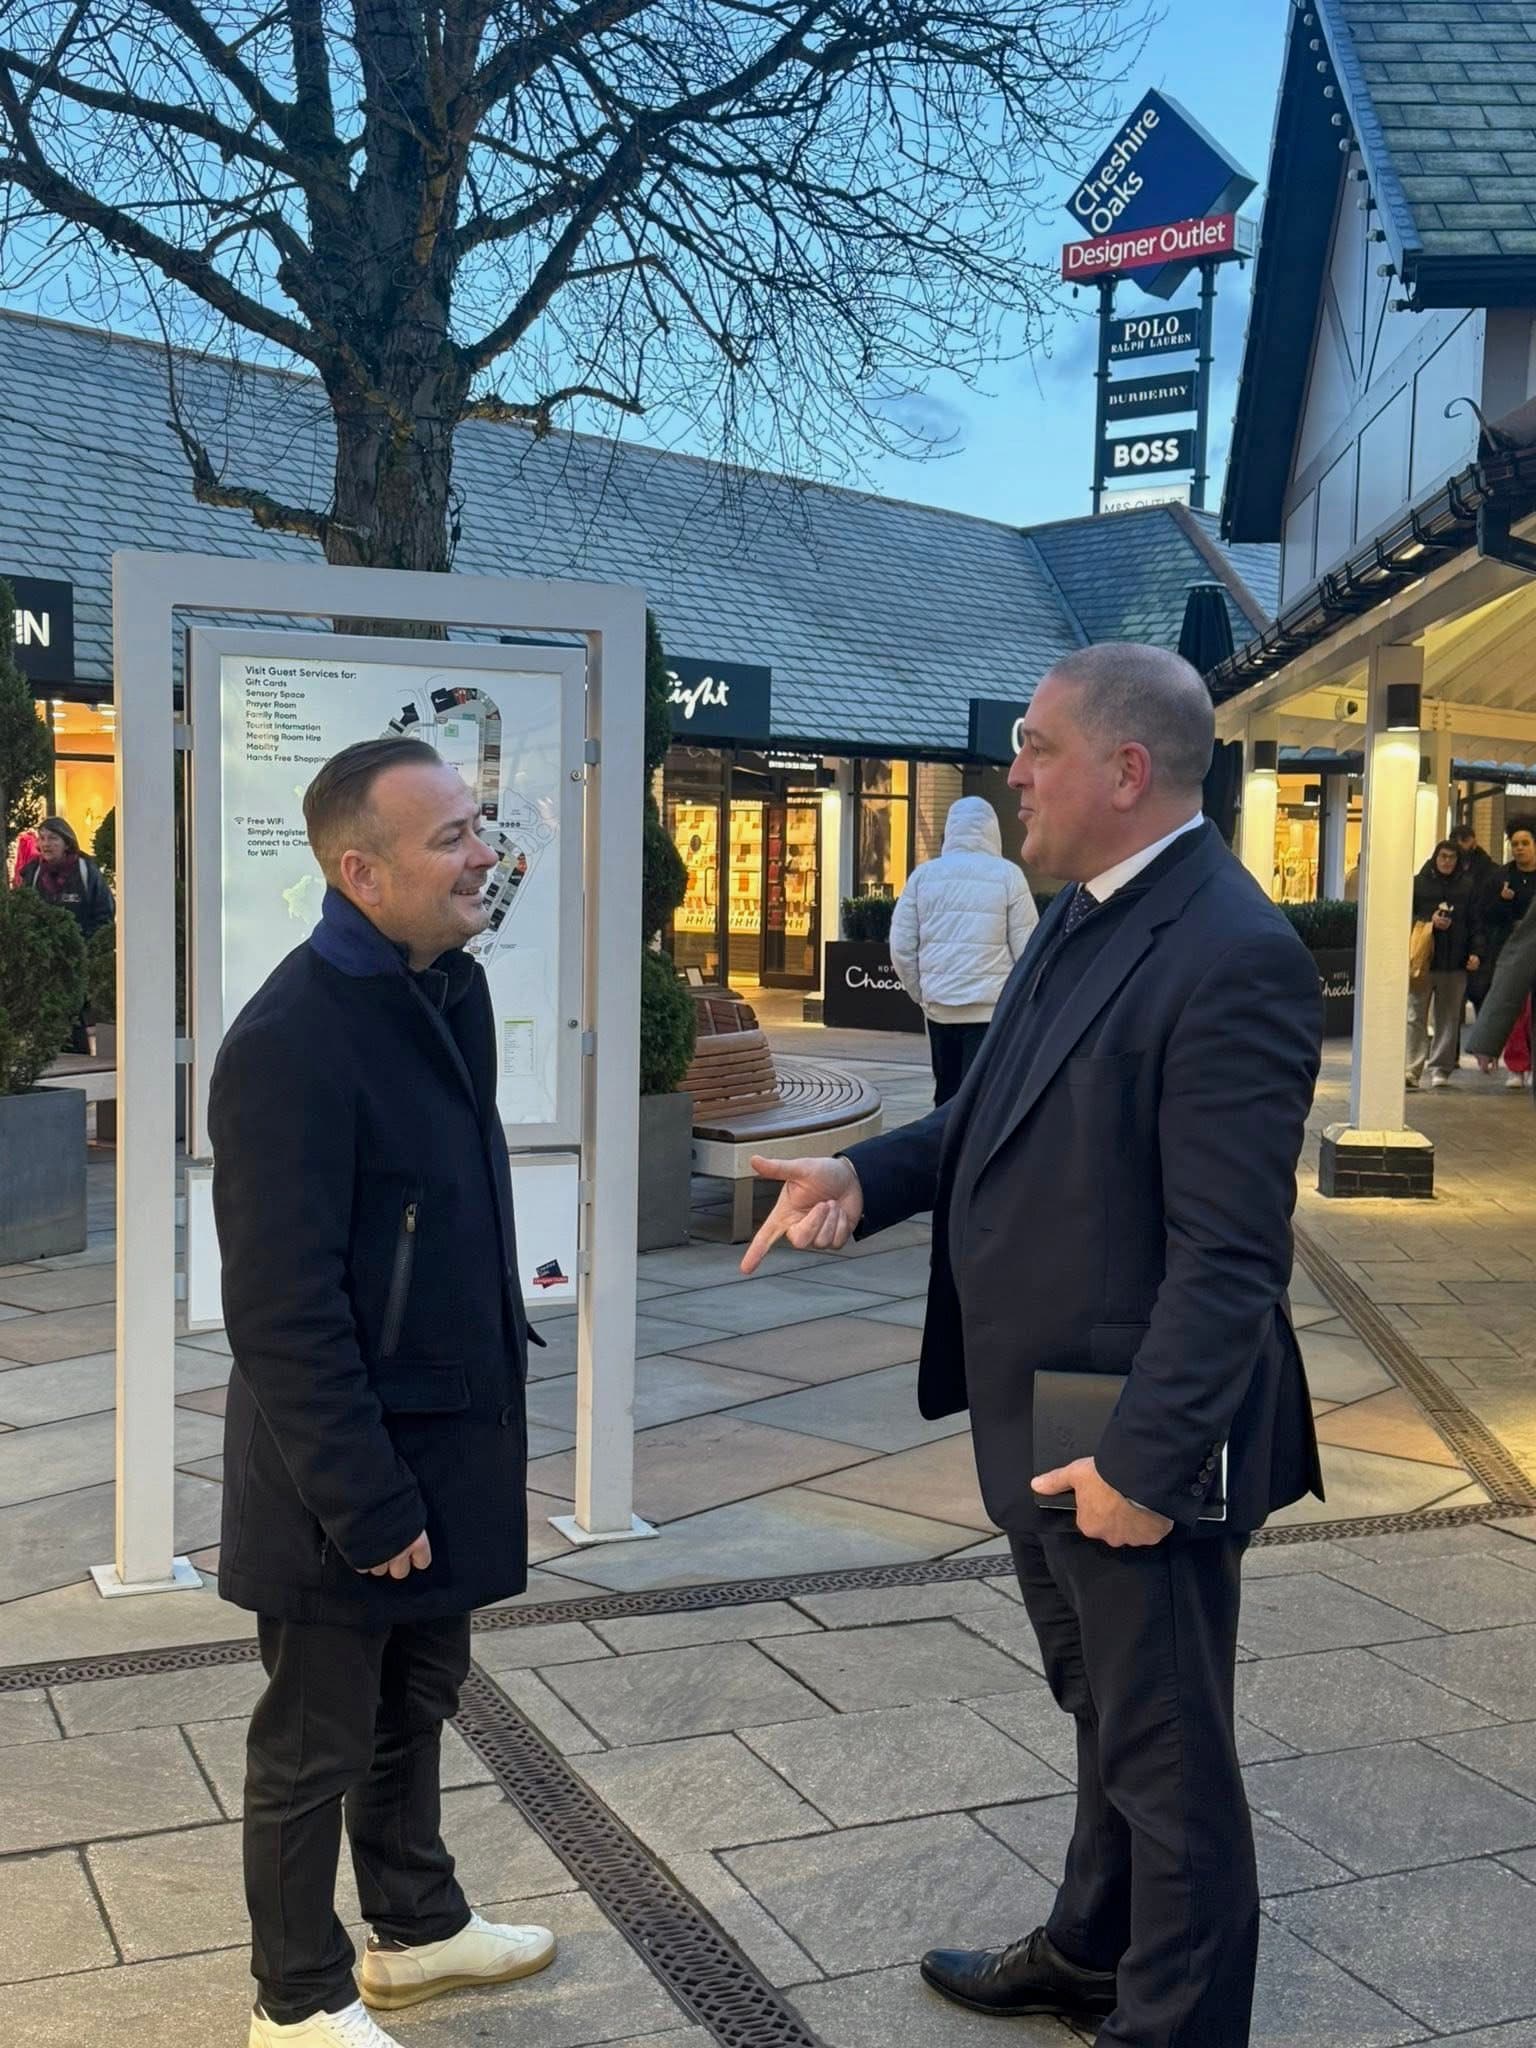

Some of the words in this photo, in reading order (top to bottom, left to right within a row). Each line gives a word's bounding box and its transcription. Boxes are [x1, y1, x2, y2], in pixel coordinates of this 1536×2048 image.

[1075, 108, 1161, 216] Cheshire
[1091, 171, 1144, 234] Oaks
[1068, 235, 1157, 269] Designer
[1159, 221, 1226, 252] Outlet
[1124, 316, 1179, 341] POLO
[1111, 340, 1145, 353] RALPH
[1150, 333, 1192, 348] LAUREN
[1109, 385, 1188, 405] BURBERRY
[1113, 438, 1179, 468] BOSS
[11, 609, 49, 647] IN
[245, 665, 265, 676] Visit
[268, 666, 296, 677] Guest
[300, 667, 339, 679] Services
[341, 670, 357, 680] for:
[245, 678, 261, 687] Gift
[263, 679, 287, 688] Cards
[246, 689, 278, 700] Sensory
[280, 690, 306, 700] Space
[246, 700, 272, 710] Prayer
[274, 701, 297, 710] Room
[246, 710, 272, 720] Family
[274, 711, 297, 720] Room
[246, 721, 273, 730] Tourist
[274, 722, 321, 731] Information
[281, 733, 304, 742] Room
[306, 734, 322, 742] Hire
[246, 754, 273, 762] Hands
[274, 754, 292, 763] Free
[247, 817, 265, 825] Free
[247, 828, 274, 837] Simply
[276, 829, 306, 838] register
[247, 839, 280, 847] connect
[282, 839, 291, 847] to
[247, 849, 259, 857] for
